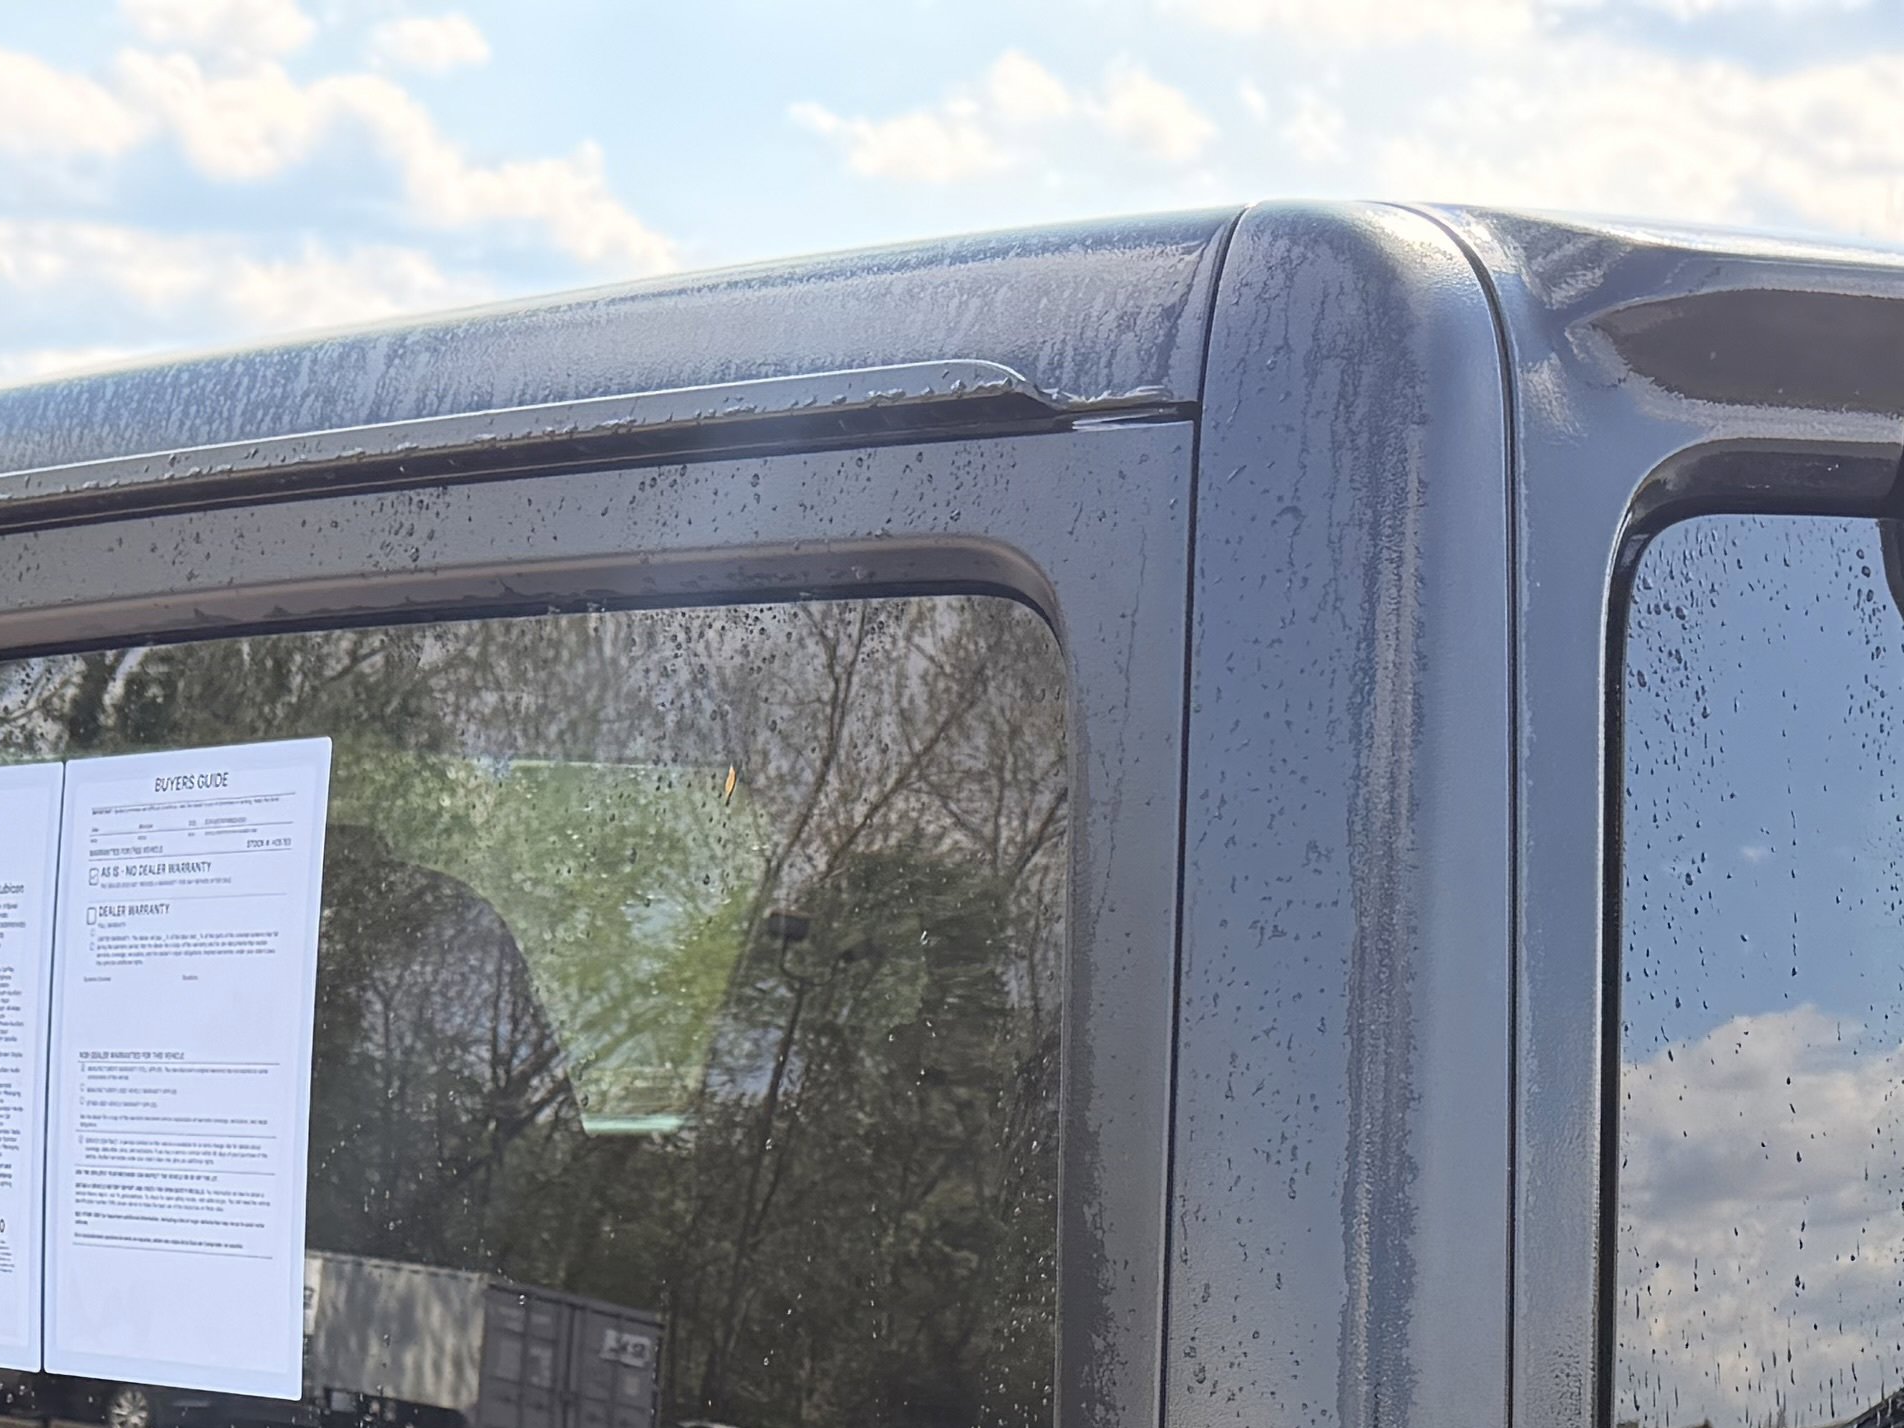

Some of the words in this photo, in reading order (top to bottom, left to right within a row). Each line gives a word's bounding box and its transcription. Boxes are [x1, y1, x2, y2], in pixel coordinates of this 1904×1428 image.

[154, 775, 195, 793] BUYERS
[197, 772, 229, 789] GUIDE
[100, 865, 111, 877] AS
[112, 865, 120, 877] IS
[125, 864, 137, 877] NO
[139, 863, 166, 876] DEALER
[168, 861, 212, 874] WARRANTY
[98, 905, 126, 918] DEALER
[128, 903, 171, 916] WARRANTY
